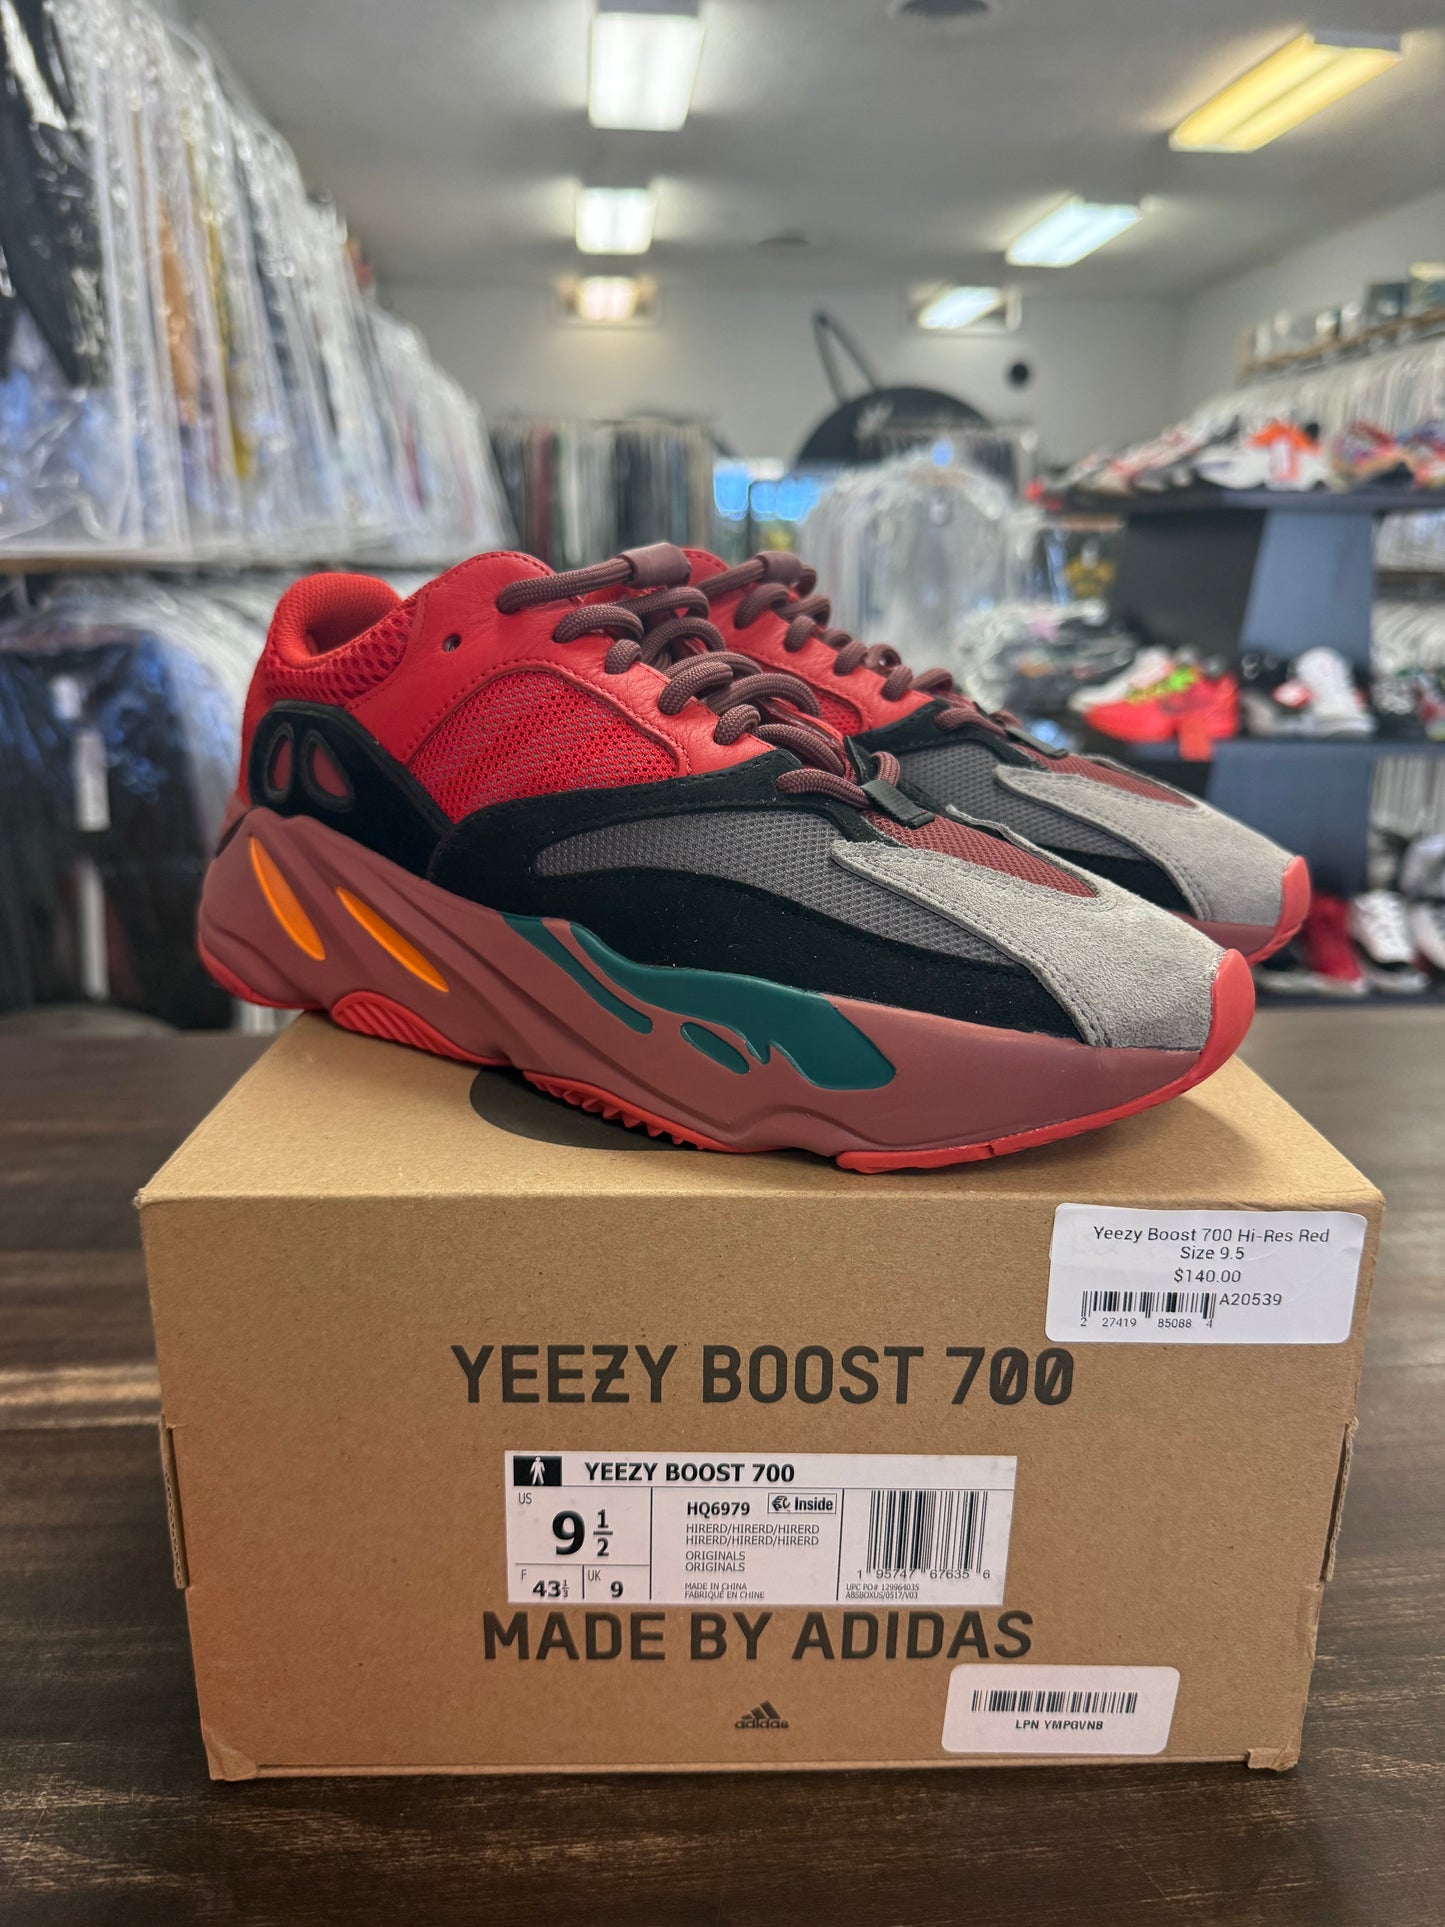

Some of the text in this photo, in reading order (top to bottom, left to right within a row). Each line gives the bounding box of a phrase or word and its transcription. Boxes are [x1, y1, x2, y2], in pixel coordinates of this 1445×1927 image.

[1093, 1226, 1330, 1244] Yeezy Boost 700 Hi-Res Red
[1180, 1246, 1245, 1260] Size 9.5
[1173, 1267, 1242, 1284] $140.00
[1219, 1293, 1283, 1307] A20539
[1080, 1317, 1213, 1328] 2 27419 85088 4
[450, 1344, 1075, 1406] YEEZY BOOST 700
[584, 1462, 795, 1483] YEEZY BOOST 700
[518, 1492, 533, 1504] US
[794, 1497, 834, 1511] Inside
[687, 1501, 751, 1518] HQ6979
[552, 1510, 586, 1556] 9
[686, 1523, 820, 1536] HIRERD/HIRERD/HIRERD
[685, 1535, 820, 1547] HIRERD/HIRERD/HIRERD
[685, 1551, 746, 1561] ORIGINALS
[685, 1562, 746, 1572] ORIGINALS
[521, 1569, 527, 1580] F
[588, 1570, 601, 1581] UK
[857, 1570, 991, 1579] 1 95747 67635 6
[610, 1581, 624, 1598] 9
[722, 1583, 747, 1591] CHINA
[727, 1591, 737, 1599] EN
[740, 1591, 765, 1599] CHINE
[483, 1610, 1034, 1661] MADE BY ADIDAS
[734, 1718, 789, 1729] adidas
[1015, 1719, 1103, 1731] LPN YMPGVNB
